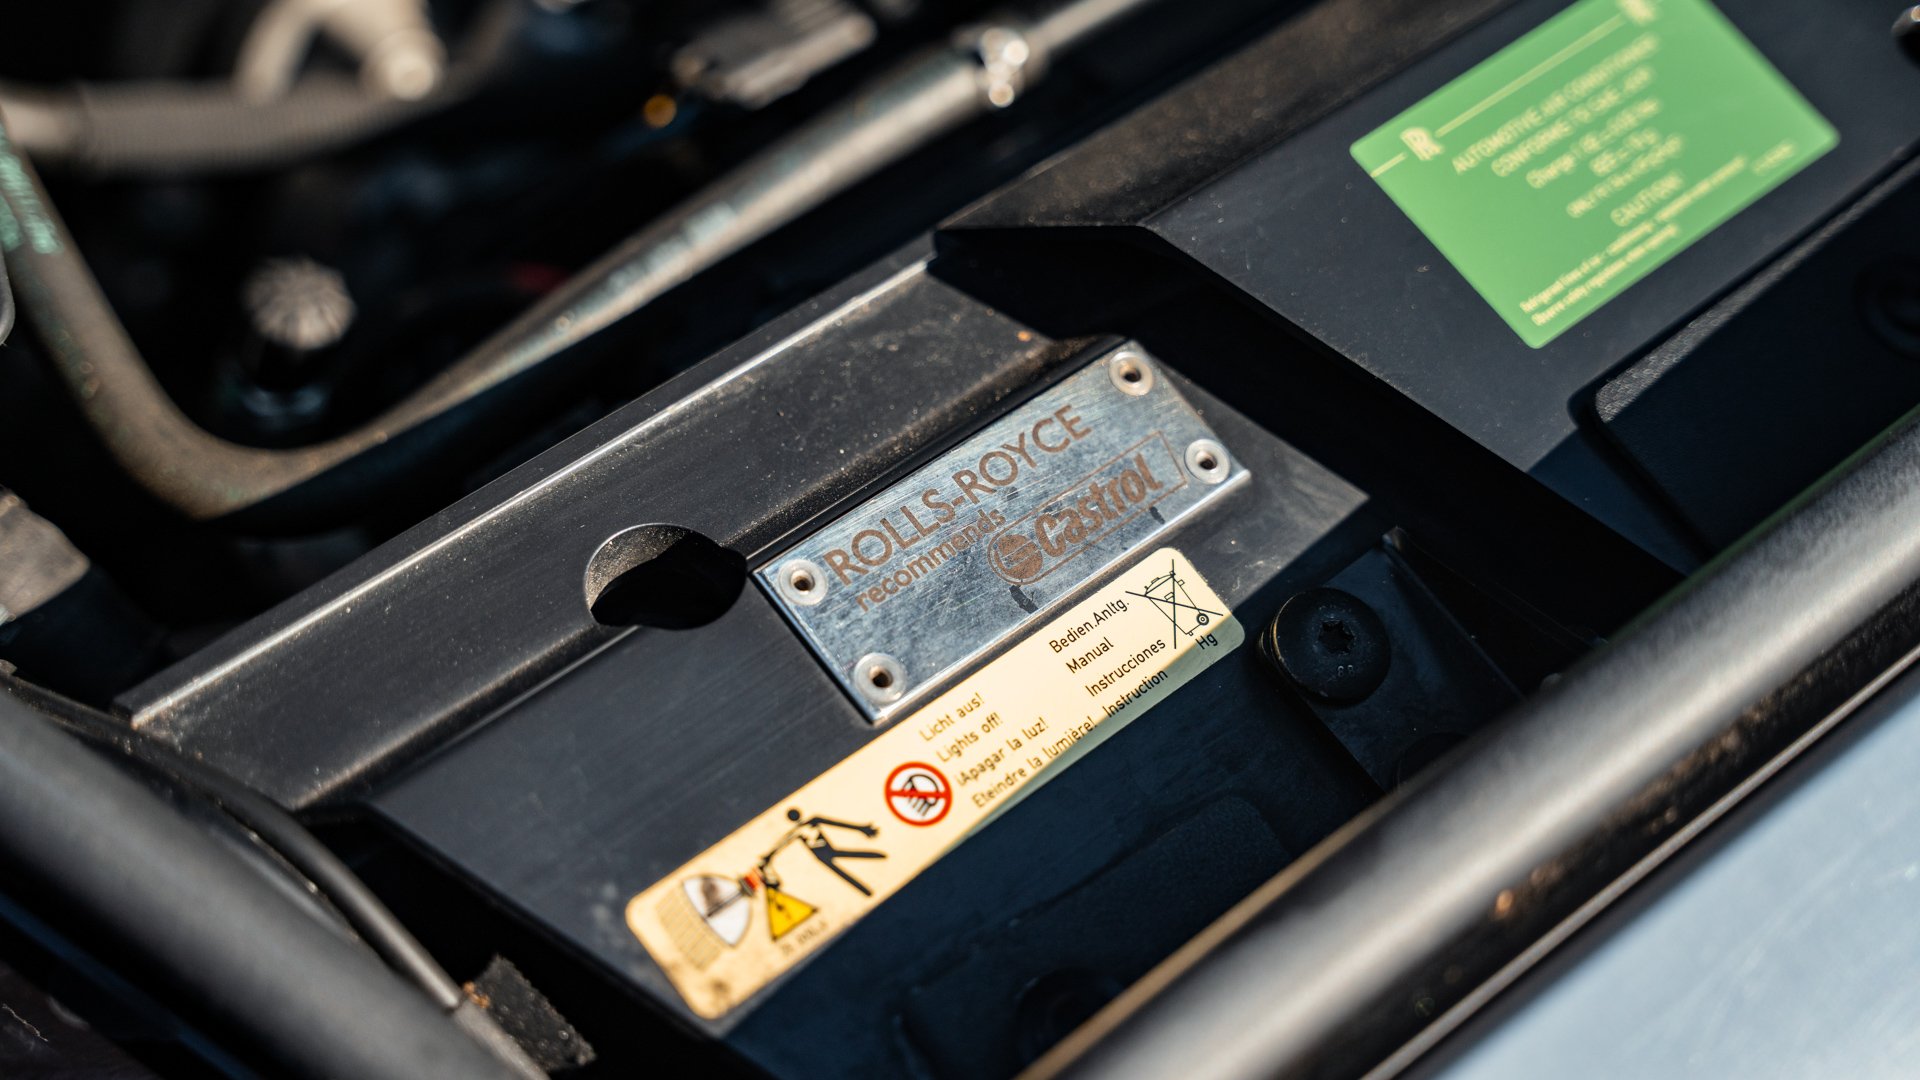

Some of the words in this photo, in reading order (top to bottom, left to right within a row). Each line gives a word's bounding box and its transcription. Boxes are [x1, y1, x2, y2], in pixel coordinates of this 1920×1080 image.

[1452, 106, 1543, 175] AUTOMOTIVE
[823, 404, 1092, 586] ROLLS-ROYCE
[1034, 453, 1164, 557] Castrol
[856, 508, 1007, 613] recommends
[1049, 599, 1130, 653] Bedien.Anltg.
[1195, 633, 1218, 650] Hg
[1066, 637, 1114, 674] Manual
[1085, 638, 1166, 697] Instrucciones
[919, 714, 955, 742] Licht
[957, 692, 985, 718] aus!
[1102, 670, 1168, 718] Instruction
[936, 730, 979, 763] Lights
[981, 712, 1003, 734] off!
[1006, 737, 1023, 751] la
[1022, 717, 1049, 740] luz!
[972, 767, 1027, 808] Eteindre
[1027, 755, 1044, 769] la
[1042, 716, 1098, 760] lumière!
